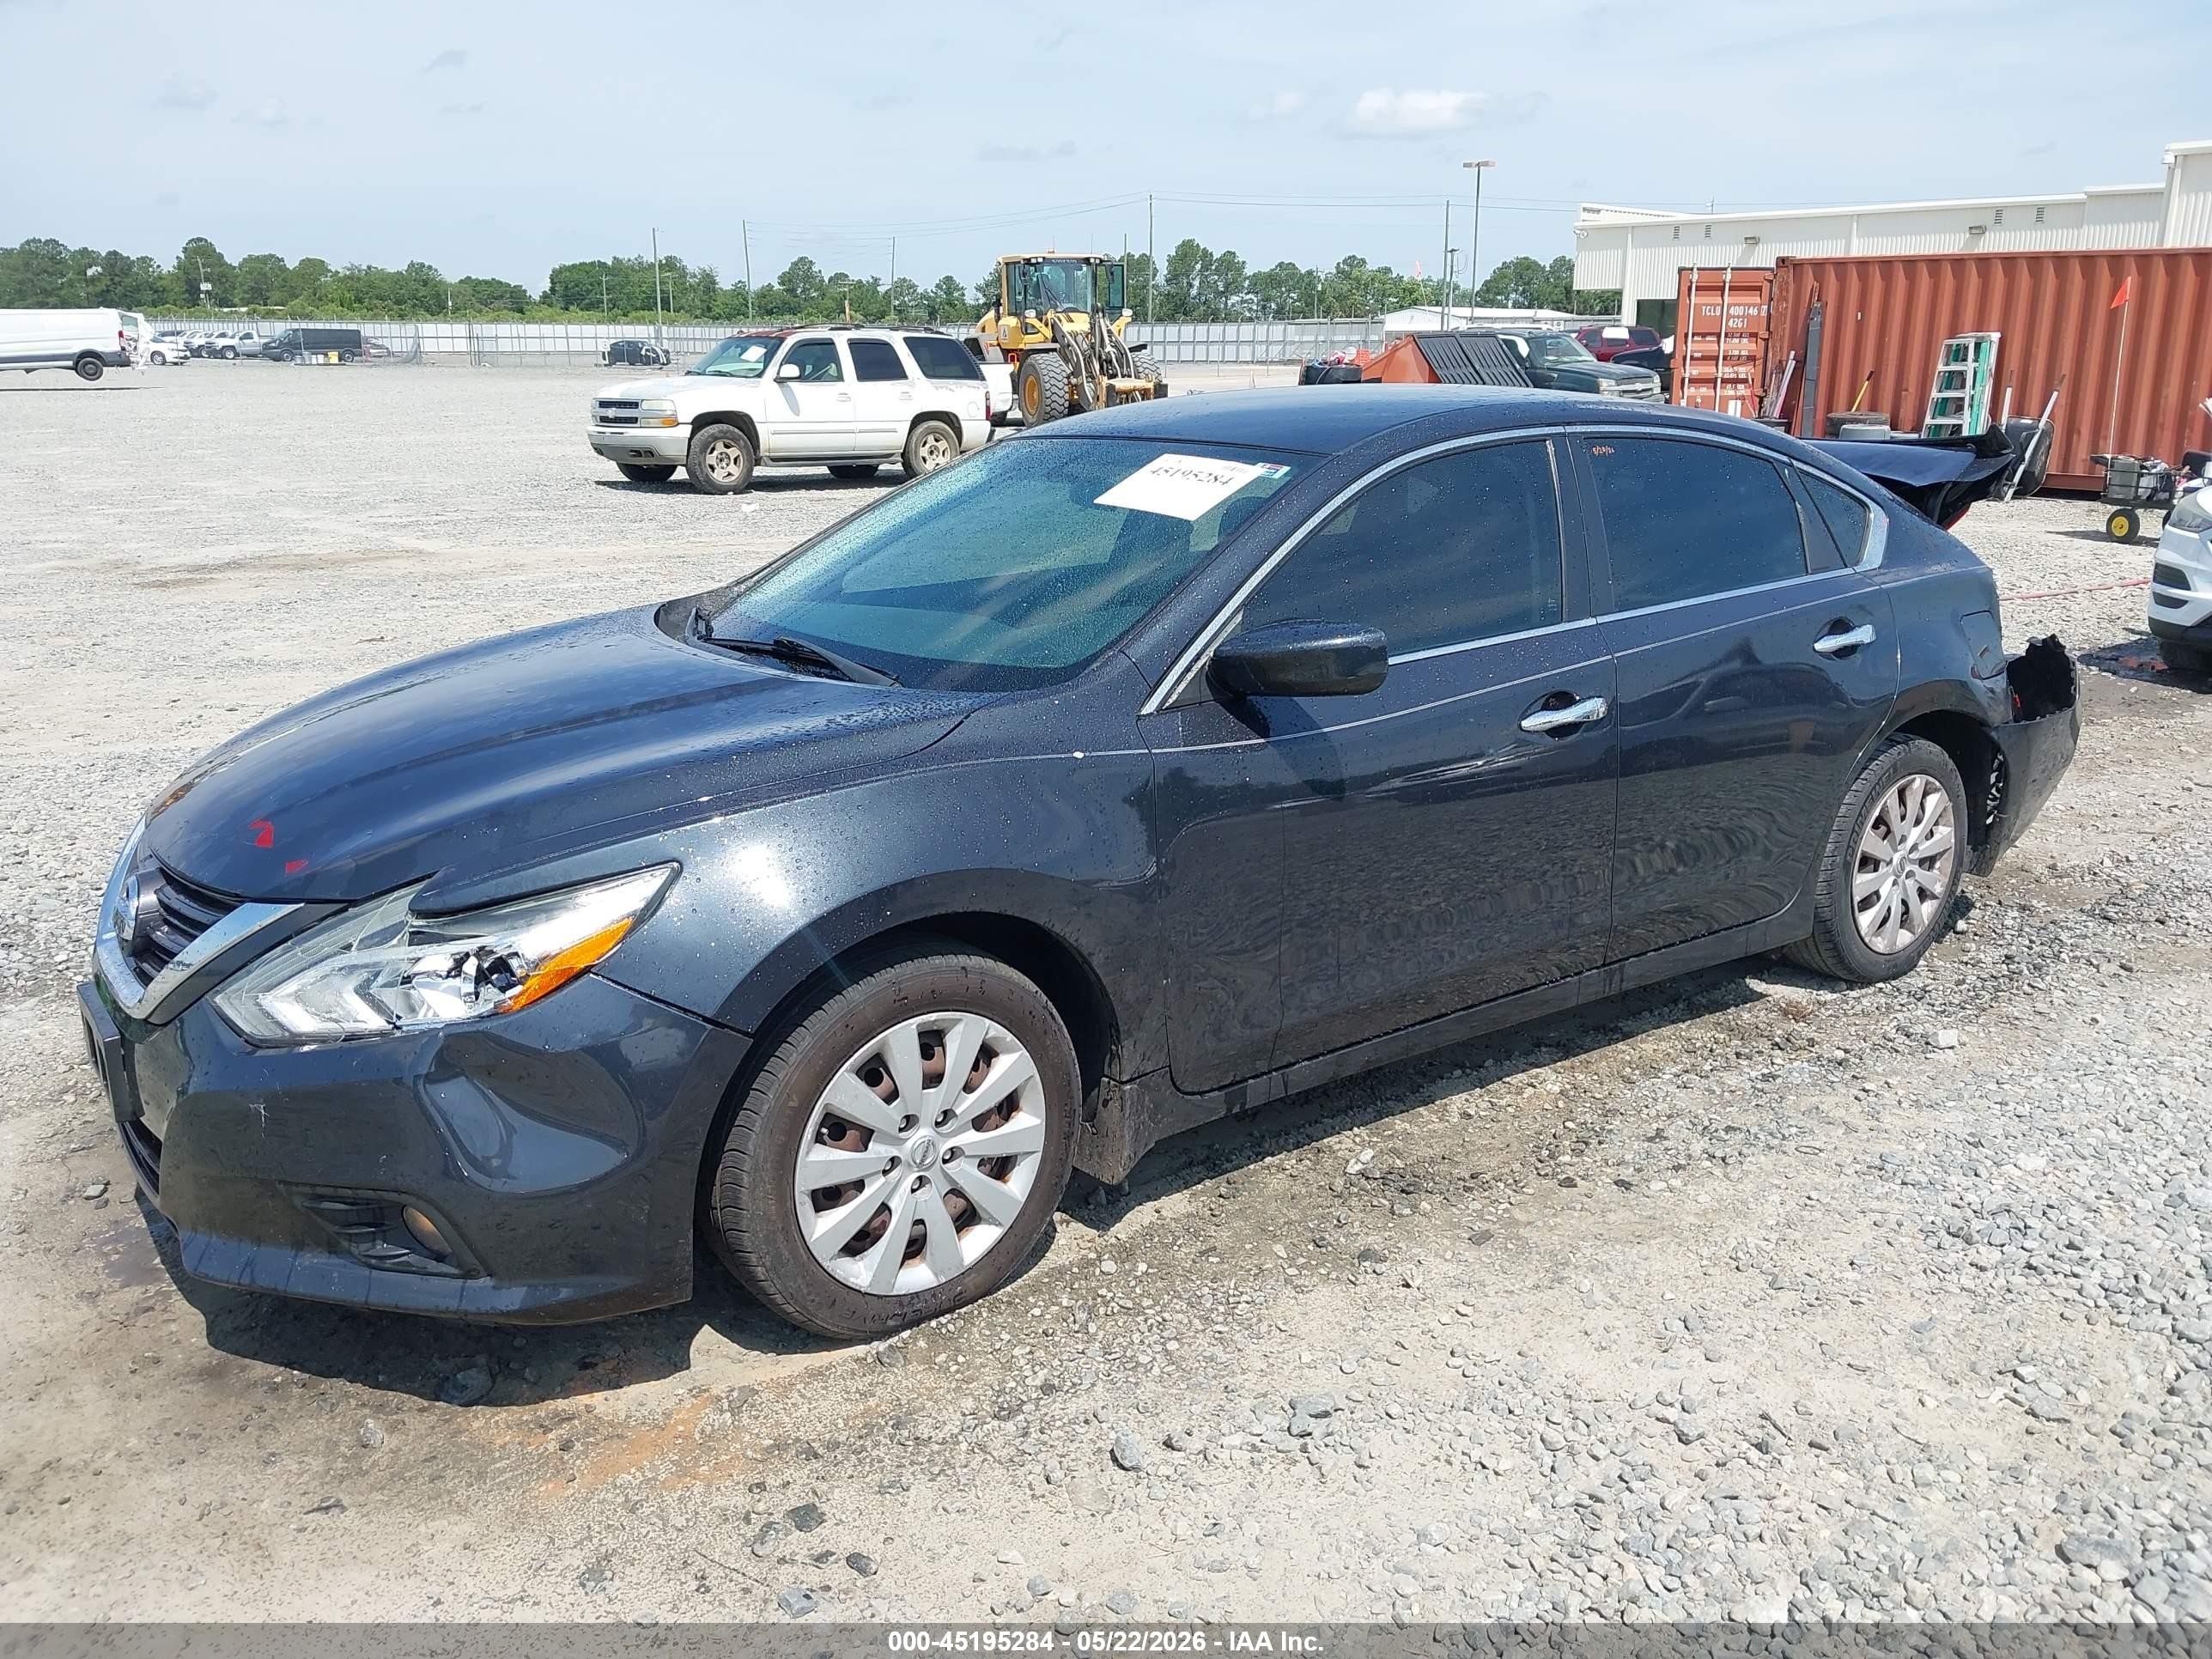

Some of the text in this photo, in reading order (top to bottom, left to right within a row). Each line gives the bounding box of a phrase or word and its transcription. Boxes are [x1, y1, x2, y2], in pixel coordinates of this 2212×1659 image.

[1702, 305, 1721, 316] TCLU
[1729, 305, 1759, 316] 400146
[1151, 466, 1235, 486] 45195284
